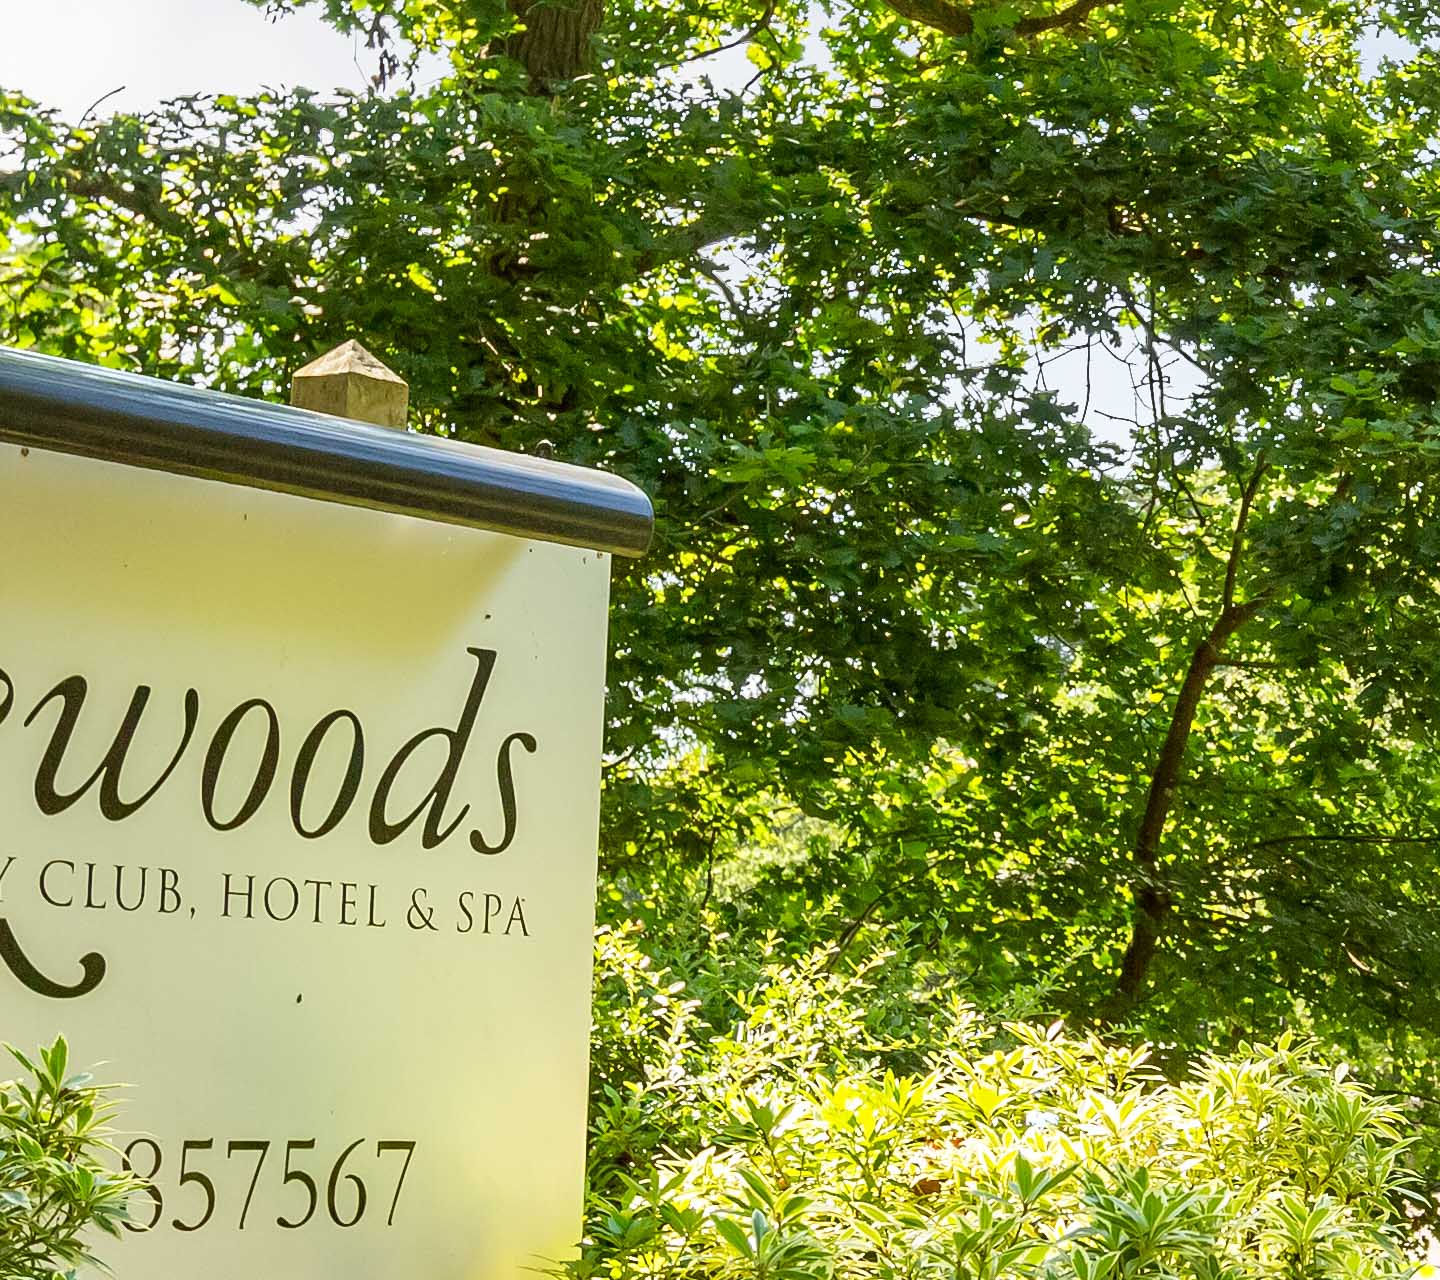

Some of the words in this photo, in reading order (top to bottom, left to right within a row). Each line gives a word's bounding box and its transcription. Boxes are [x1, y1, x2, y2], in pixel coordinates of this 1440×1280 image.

[38, 858, 197, 920] CLUB,
[220, 871, 387, 929] HOTEL
[406, 887, 440, 932] &
[455, 890, 531, 938] SPA
[119, 1136, 417, 1233] 857567
